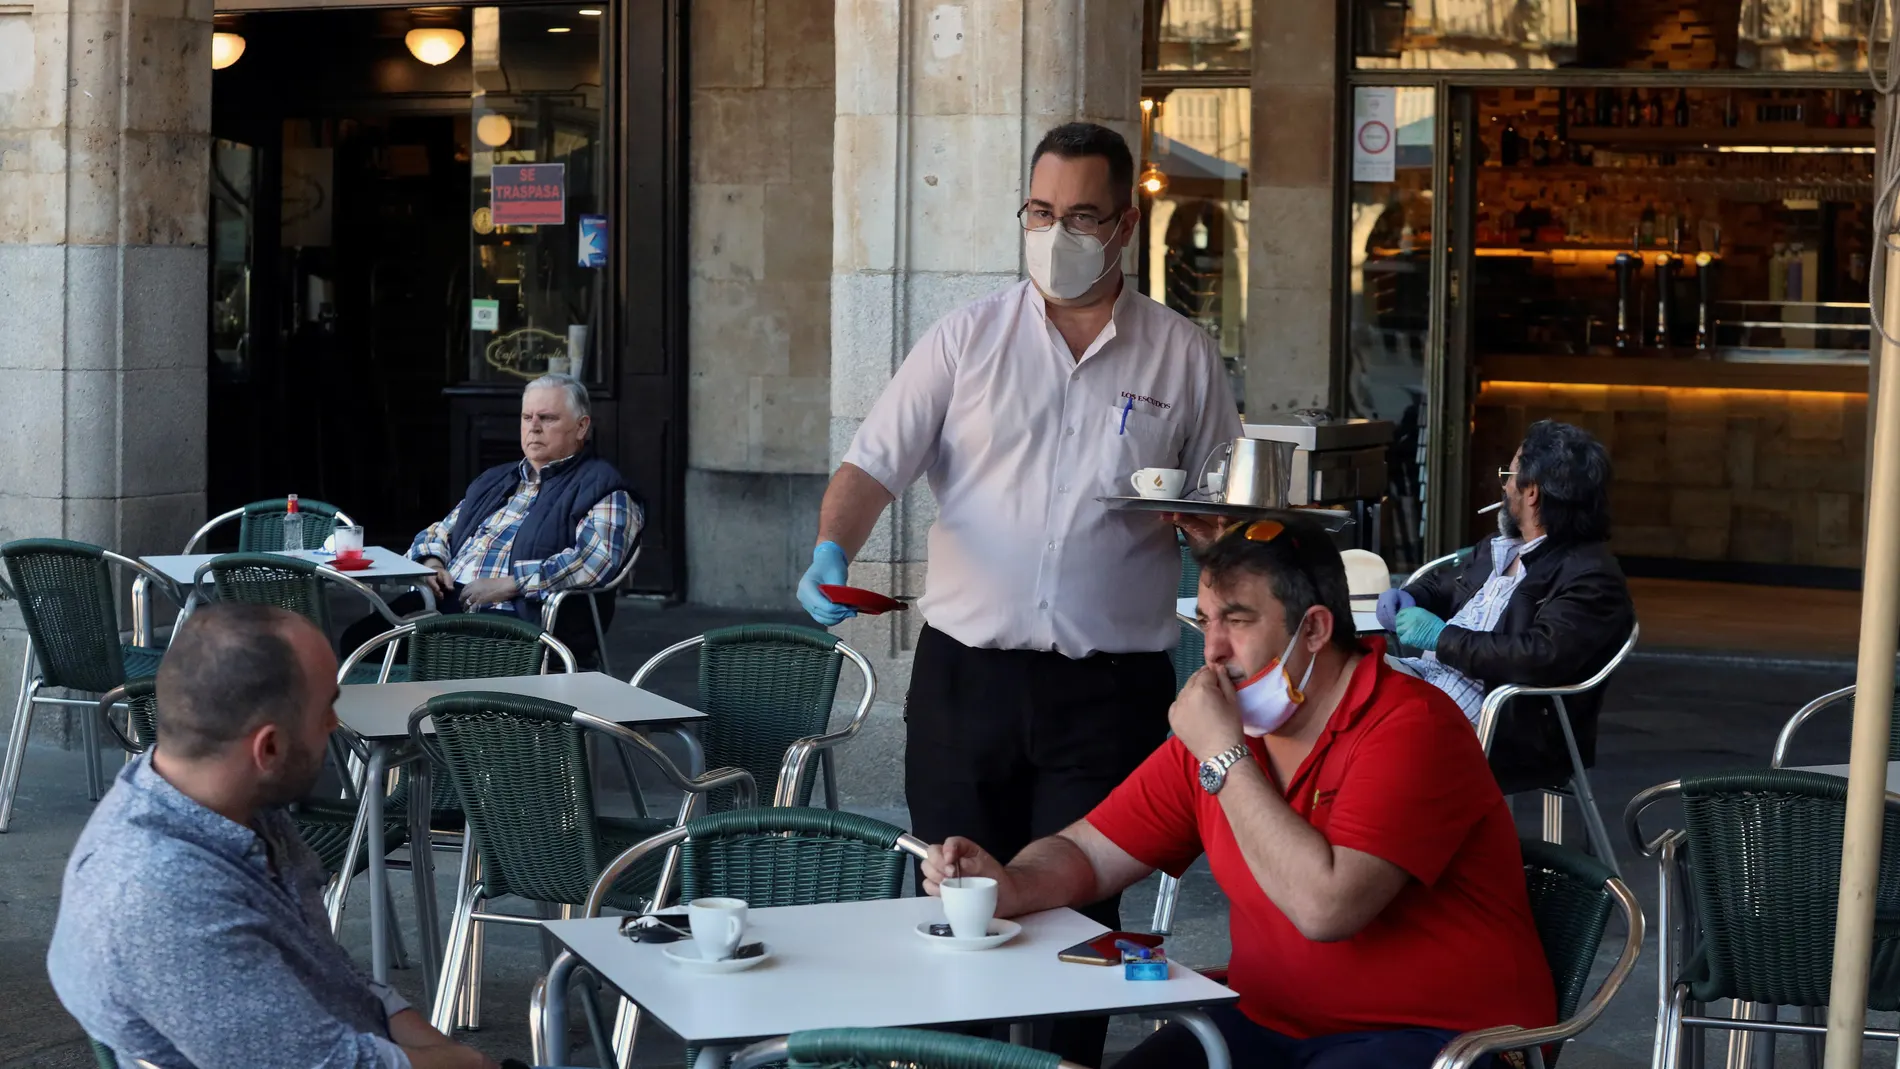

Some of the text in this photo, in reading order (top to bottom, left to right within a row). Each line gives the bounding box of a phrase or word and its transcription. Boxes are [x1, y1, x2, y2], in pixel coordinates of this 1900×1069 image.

[519, 167, 536, 181] SE
[495, 185, 560, 199] TRASPASA
[1121, 391, 1171, 409] LOS ESCUDOS
